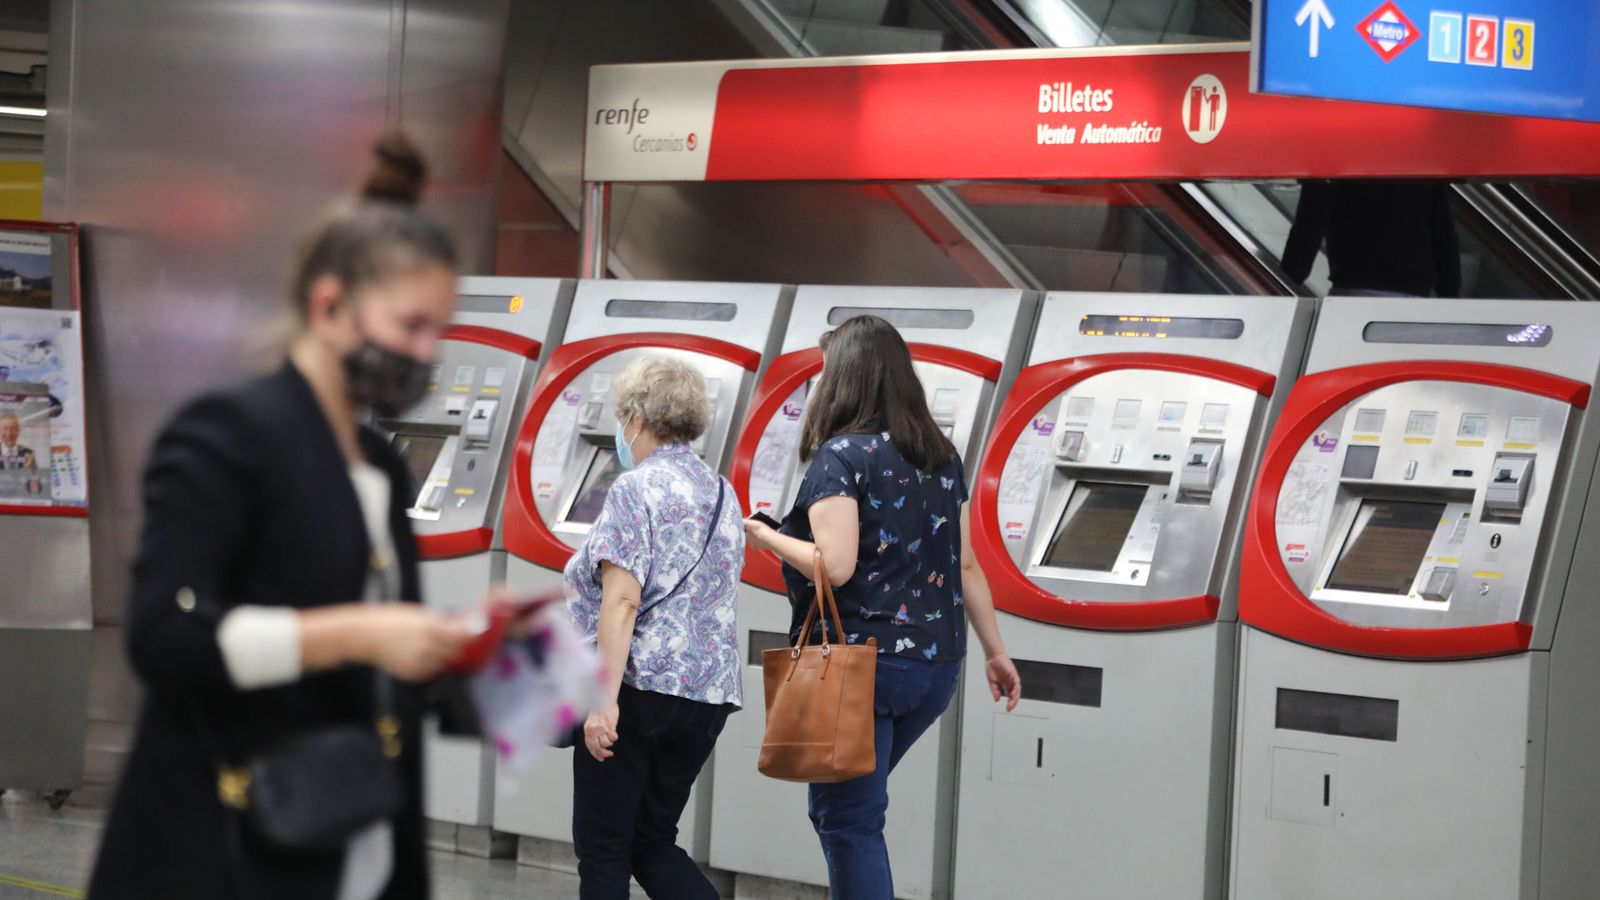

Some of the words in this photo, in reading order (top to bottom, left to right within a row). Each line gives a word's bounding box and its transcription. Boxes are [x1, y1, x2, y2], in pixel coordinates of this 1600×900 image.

[1373, 23, 1403, 41] Metro
[1440, 21, 1452, 55] 1
[1475, 26, 1489, 58] 2
[1512, 28, 1525, 61] 3
[1038, 82, 1113, 113] Billetes
[595, 98, 649, 135] renfe
[1037, 124, 1076, 144] Venta
[1081, 121, 1162, 144] Automática
